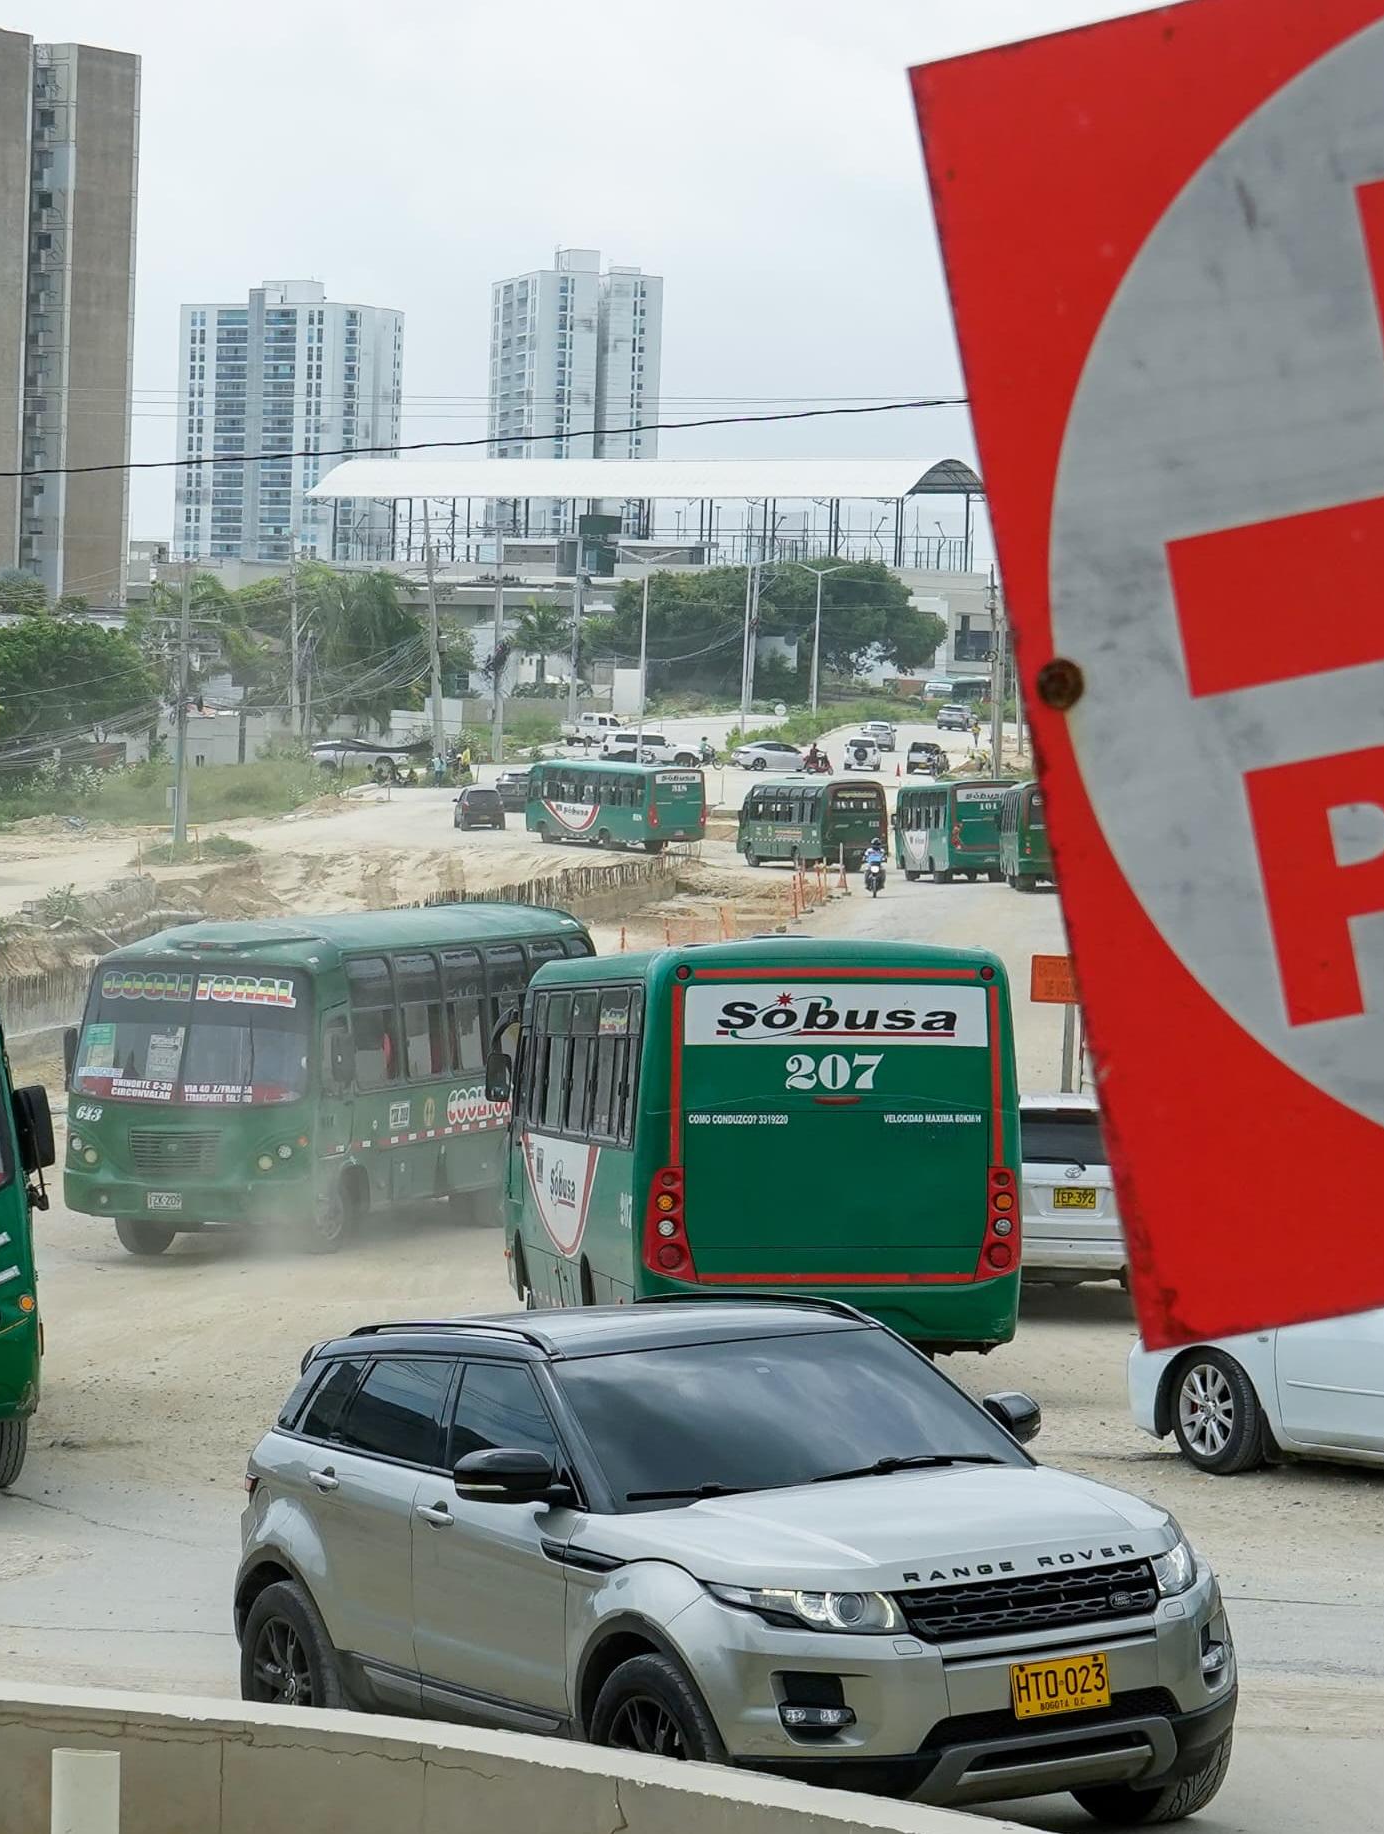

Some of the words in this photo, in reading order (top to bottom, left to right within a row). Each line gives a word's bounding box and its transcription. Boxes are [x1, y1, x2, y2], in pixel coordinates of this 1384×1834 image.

[717, 1001, 958, 1031] Sobusa
[784, 1052, 885, 1091] 207
[184, 1084, 198, 1094] VIA
[199, 1084, 211, 1093] 40
[75, 1104, 104, 1122] 643
[688, 1114, 711, 1125] COMO
[883, 1114, 924, 1123] VELOCIDAD
[925, 1114, 955, 1123] MAXIMA
[902, 1560, 1016, 1583] RANGE
[1037, 1543, 1136, 1568] ROVER
[1040, 1699, 1070, 1711] BOGOTA
